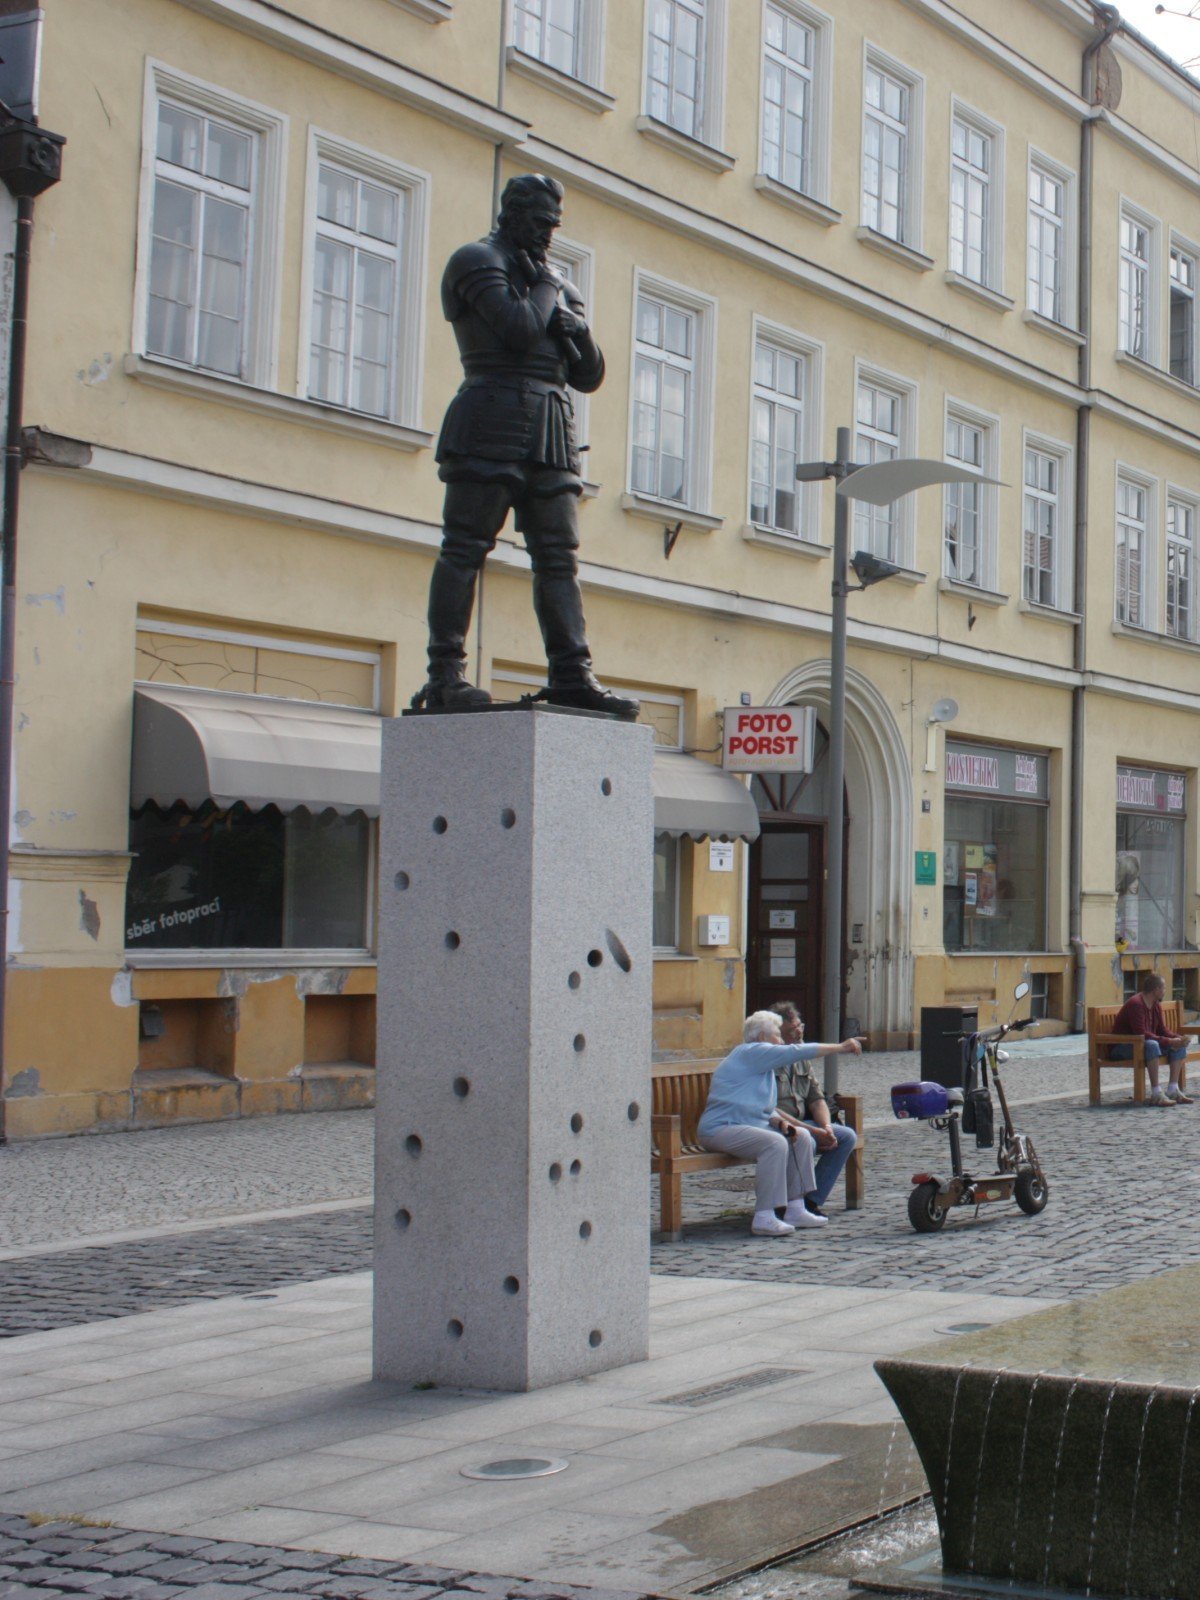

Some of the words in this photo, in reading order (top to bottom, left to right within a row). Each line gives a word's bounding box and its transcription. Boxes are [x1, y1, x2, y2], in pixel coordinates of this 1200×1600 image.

[738, 714, 792, 733] FOTO
[728, 736, 799, 755] PORST
[126, 918, 157, 940] sběr
[159, 896, 221, 929] fotoprací
